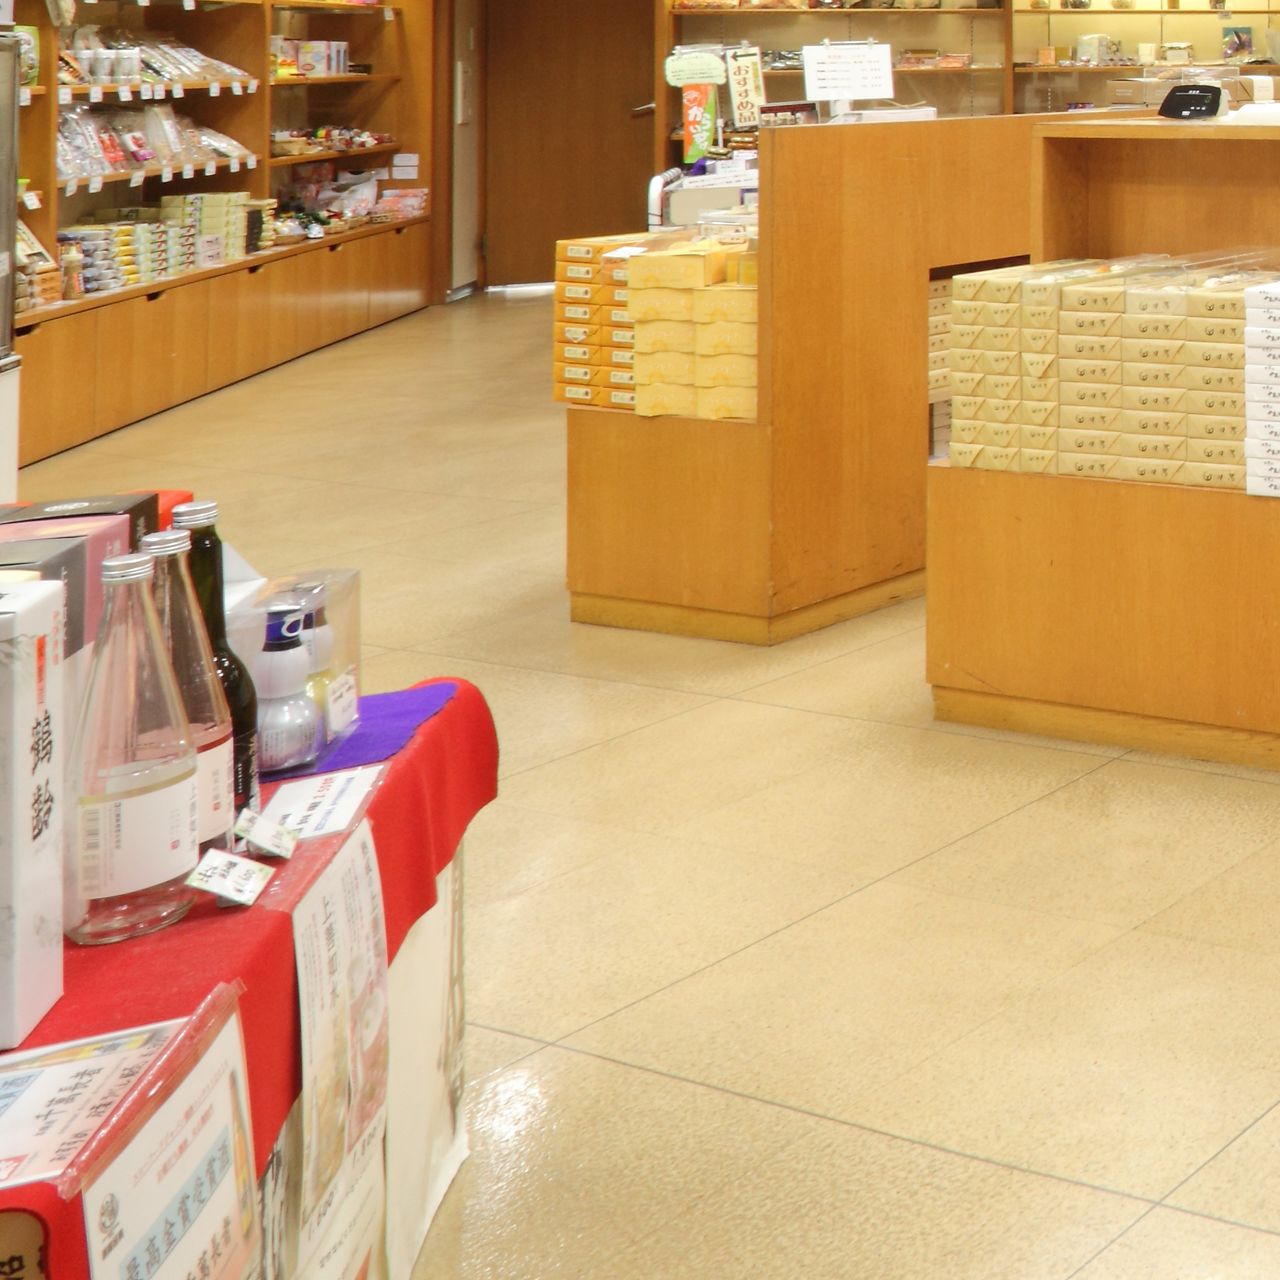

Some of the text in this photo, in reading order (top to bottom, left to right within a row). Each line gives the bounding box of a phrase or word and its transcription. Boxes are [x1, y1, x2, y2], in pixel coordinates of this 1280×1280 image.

[733, 65, 756, 125] おすすめ品
